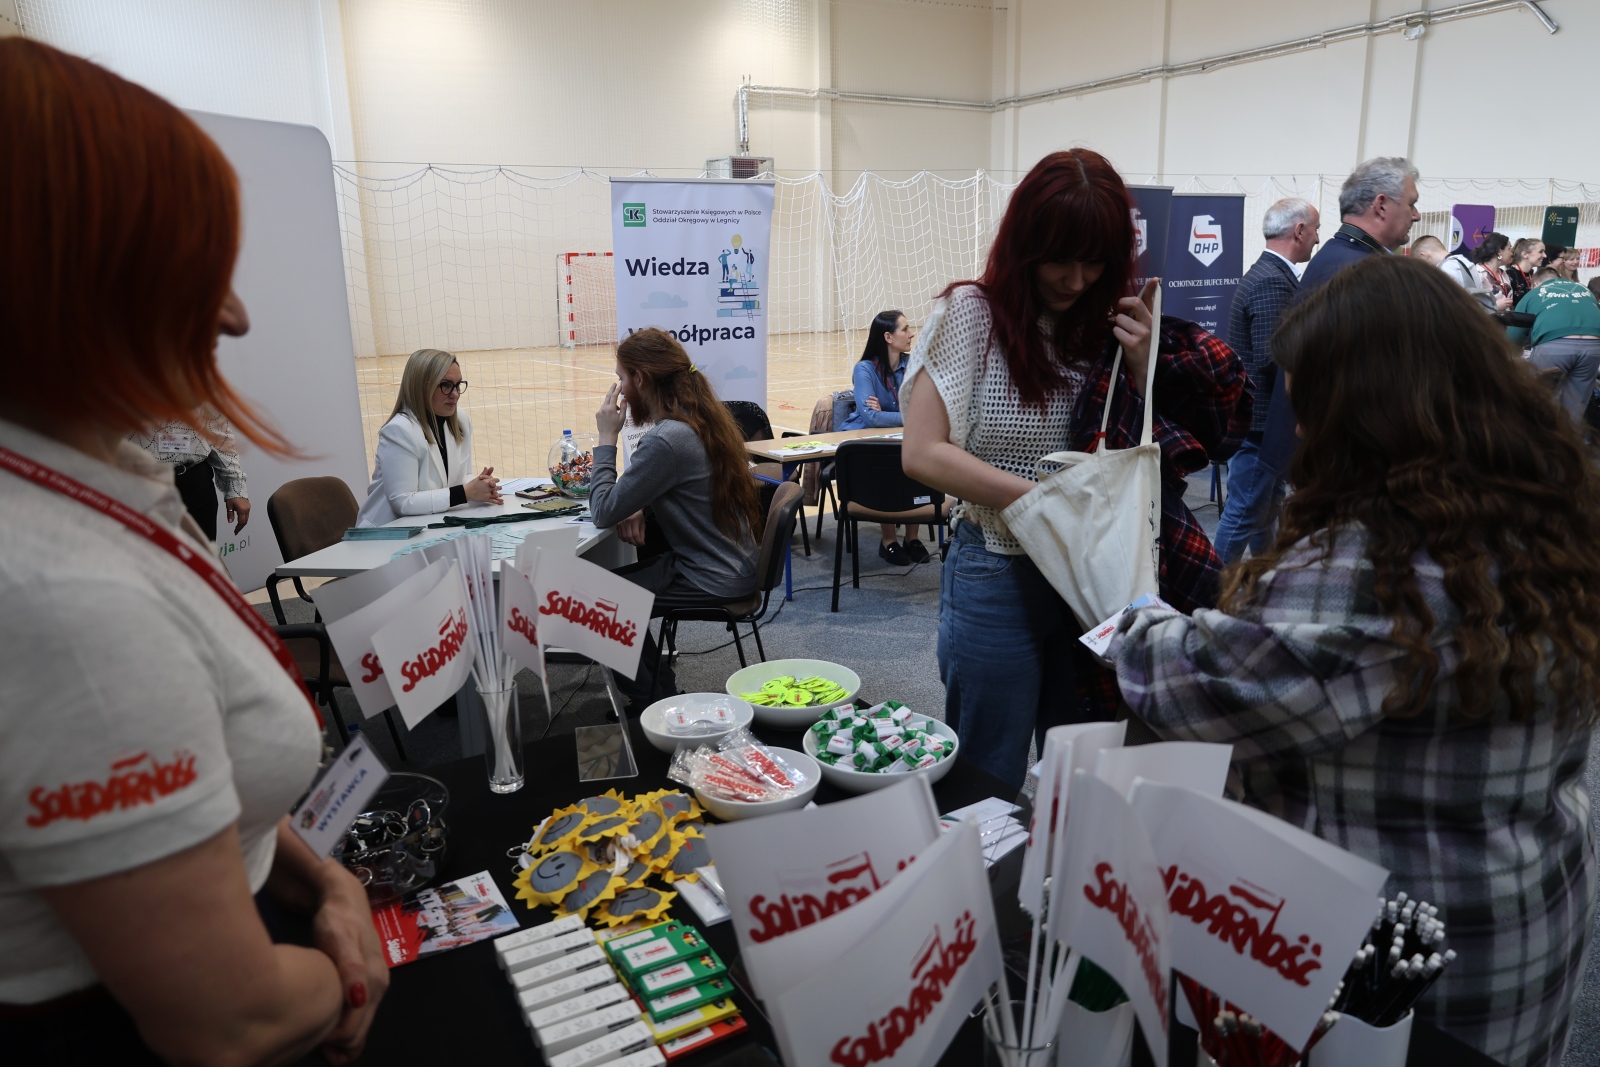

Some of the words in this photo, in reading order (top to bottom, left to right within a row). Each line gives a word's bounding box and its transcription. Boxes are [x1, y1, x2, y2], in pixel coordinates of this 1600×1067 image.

[652, 208, 700, 216] Stowarzyszenie
[700, 208, 737, 217] Księgowych
[678, 217, 709, 225] Okręgowy
[716, 217, 740, 225] Legnicy
[1194, 242, 1219, 254] OHP
[625, 257, 710, 277] Wiedza
[1168, 279, 1203, 288] OCHOTNICZE
[1203, 278, 1223, 287] HUFCE
[1223, 277, 1240, 285] PRACY
[1194, 304, 1217, 312] www.ohp.pl
[317, 768, 368, 832] WYSTAWCA
